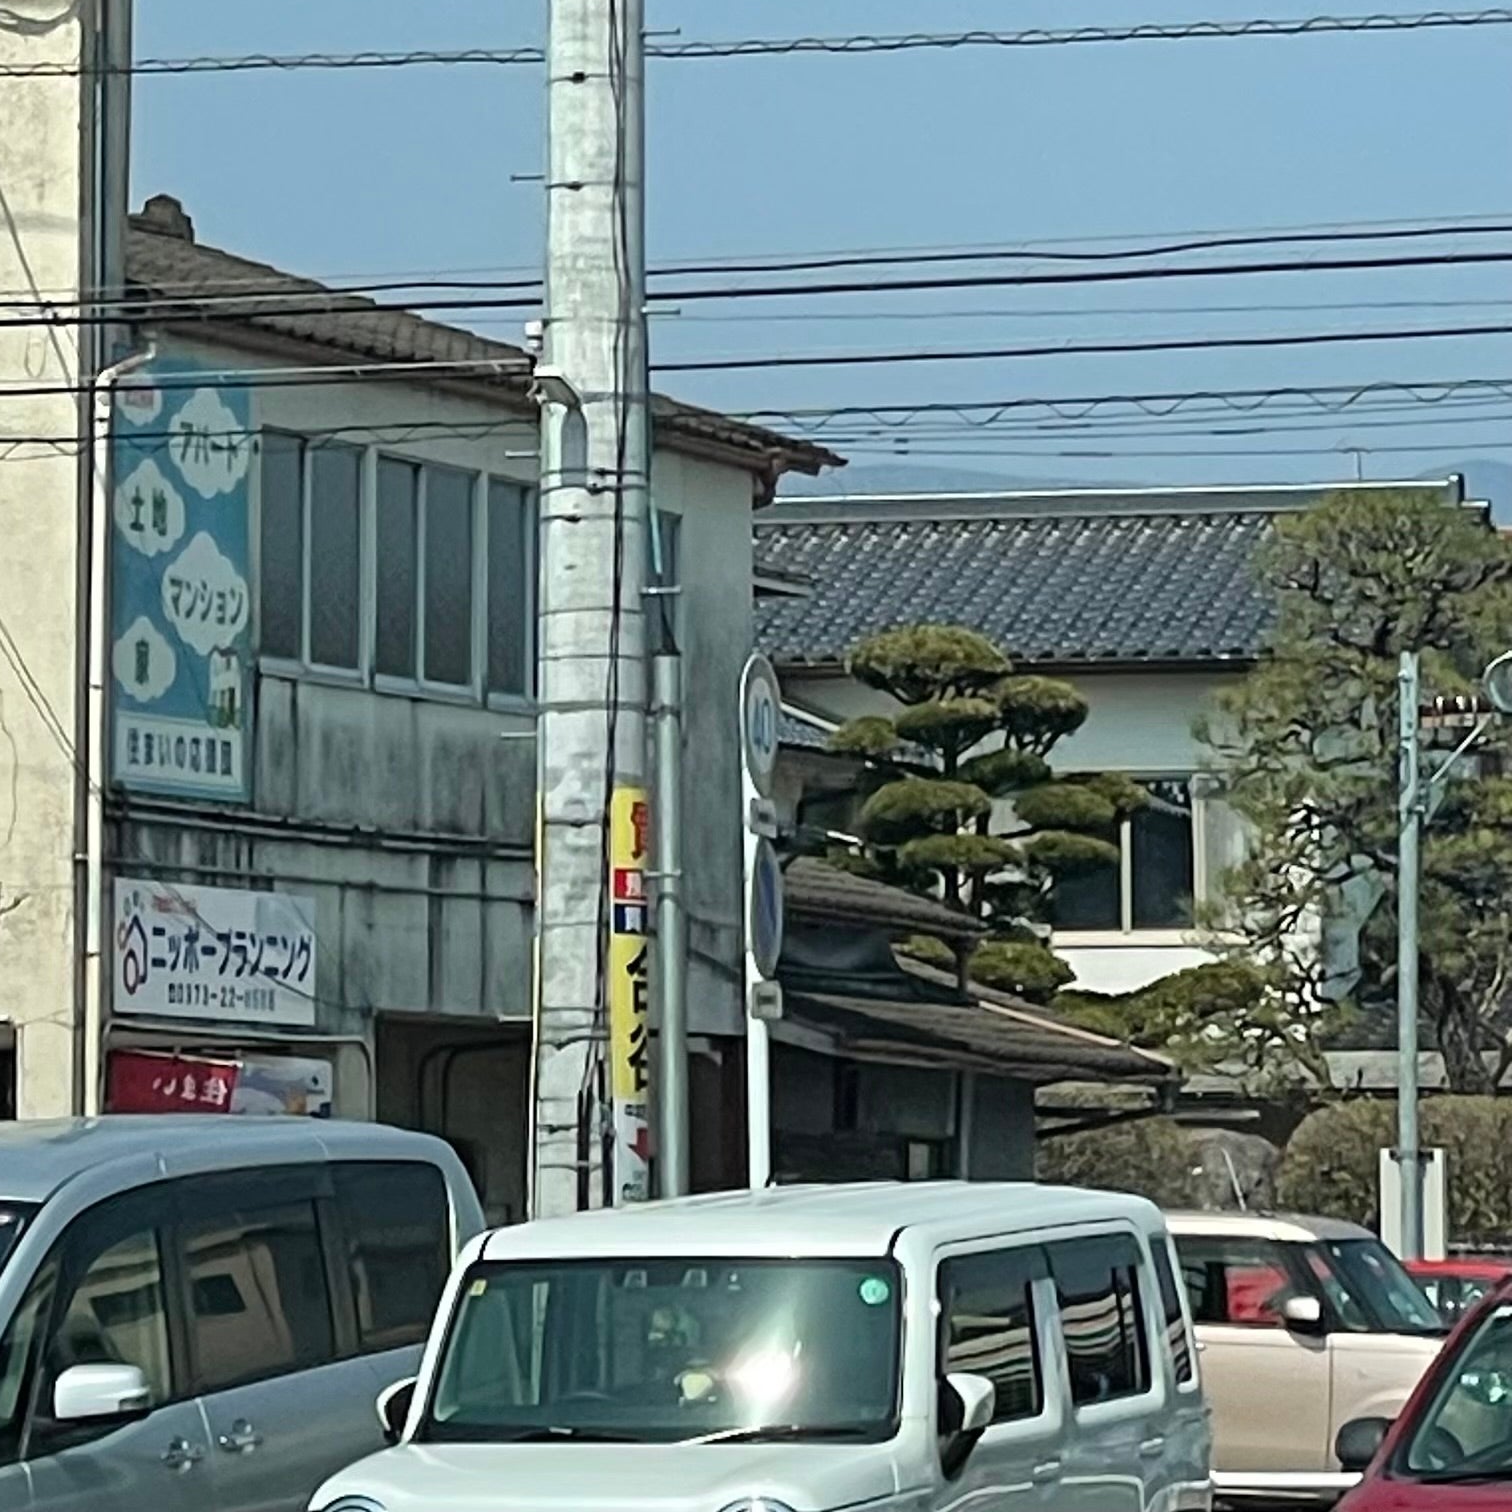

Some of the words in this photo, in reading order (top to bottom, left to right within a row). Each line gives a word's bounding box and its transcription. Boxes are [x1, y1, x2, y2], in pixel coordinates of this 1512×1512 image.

[168, 575, 244, 625] マンション
[152, 922, 313, 982] ニッポープランニング
